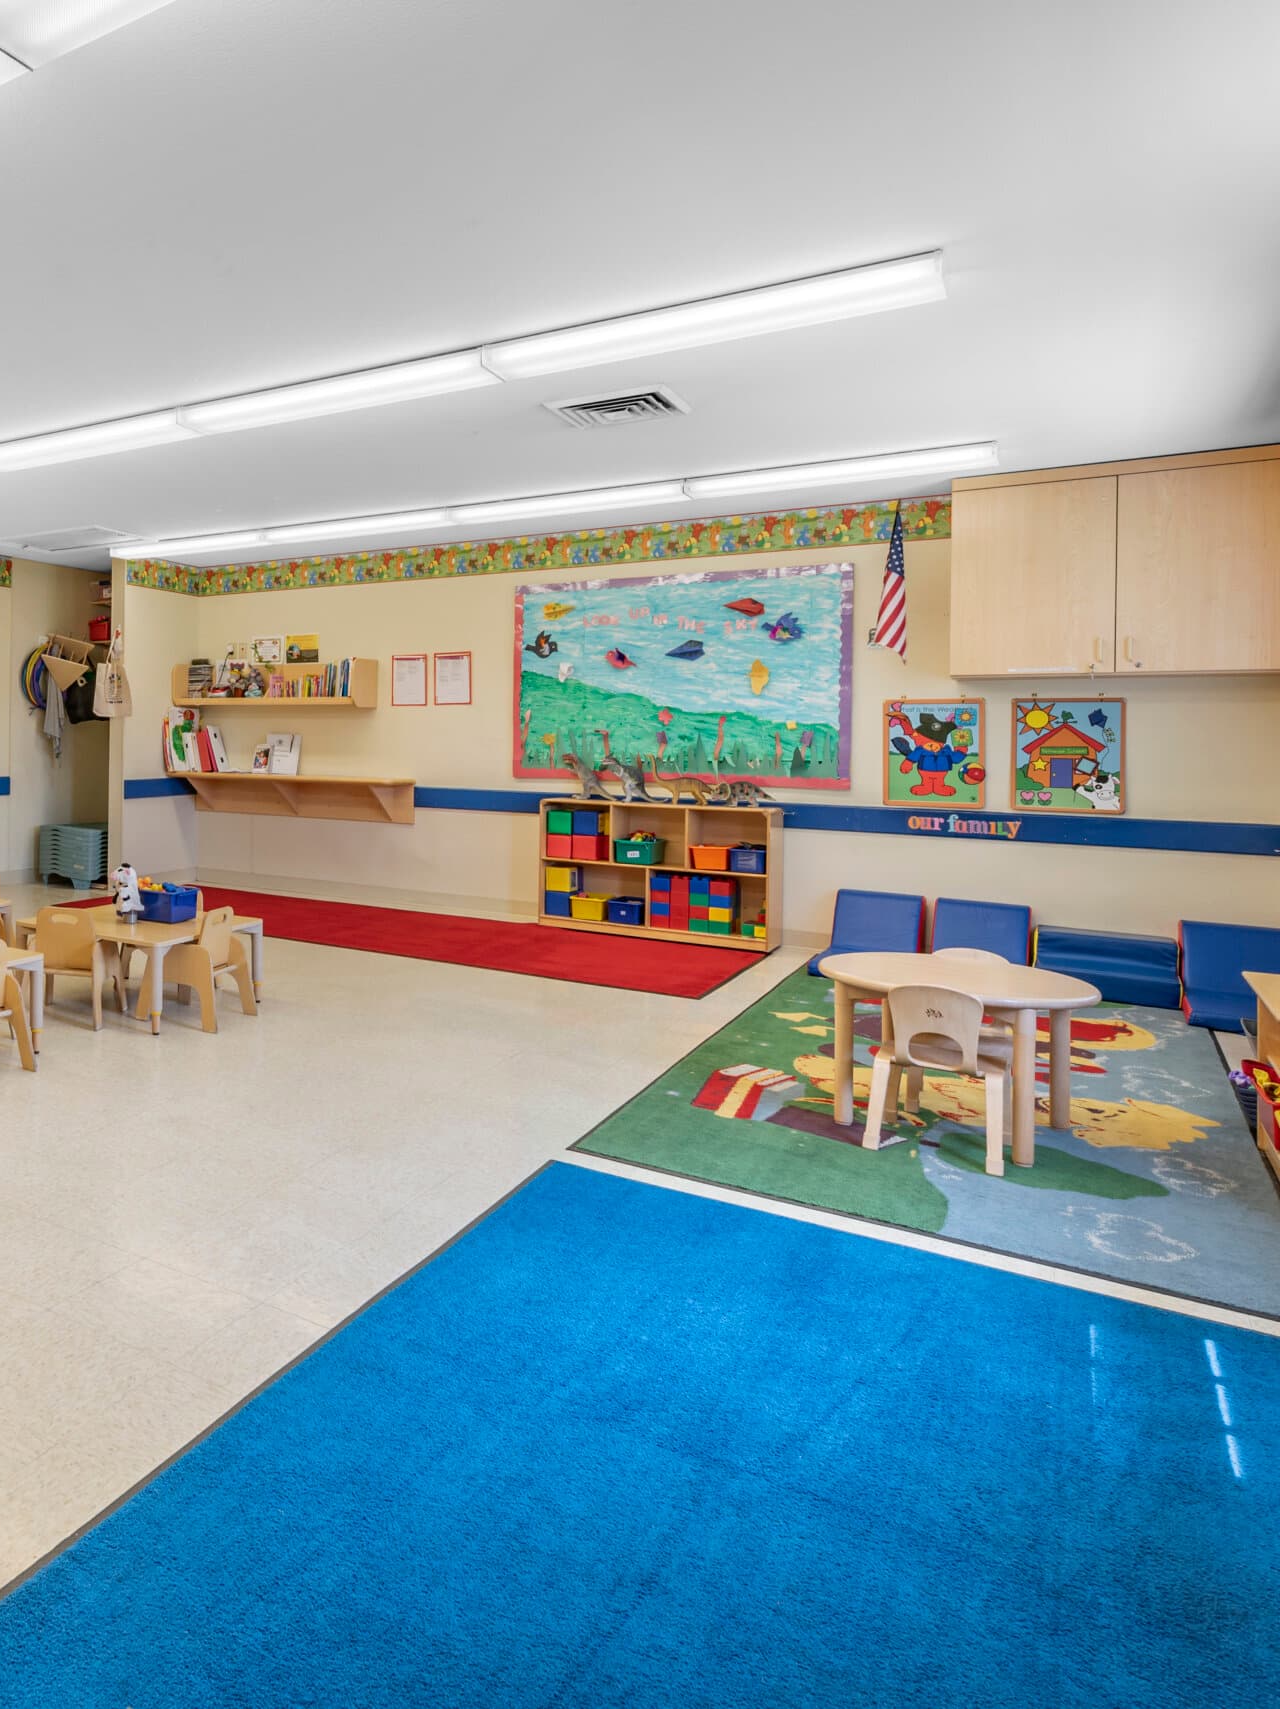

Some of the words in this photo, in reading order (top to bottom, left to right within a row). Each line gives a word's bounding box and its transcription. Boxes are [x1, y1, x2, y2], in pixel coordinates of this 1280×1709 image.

[583, 615, 619, 628] LOOK
[628, 606, 650, 620] UP
[652, 613, 669, 625] IN
[677, 615, 705, 635] THE
[723, 618, 759, 636] SKY
[907, 815, 944, 831] our
